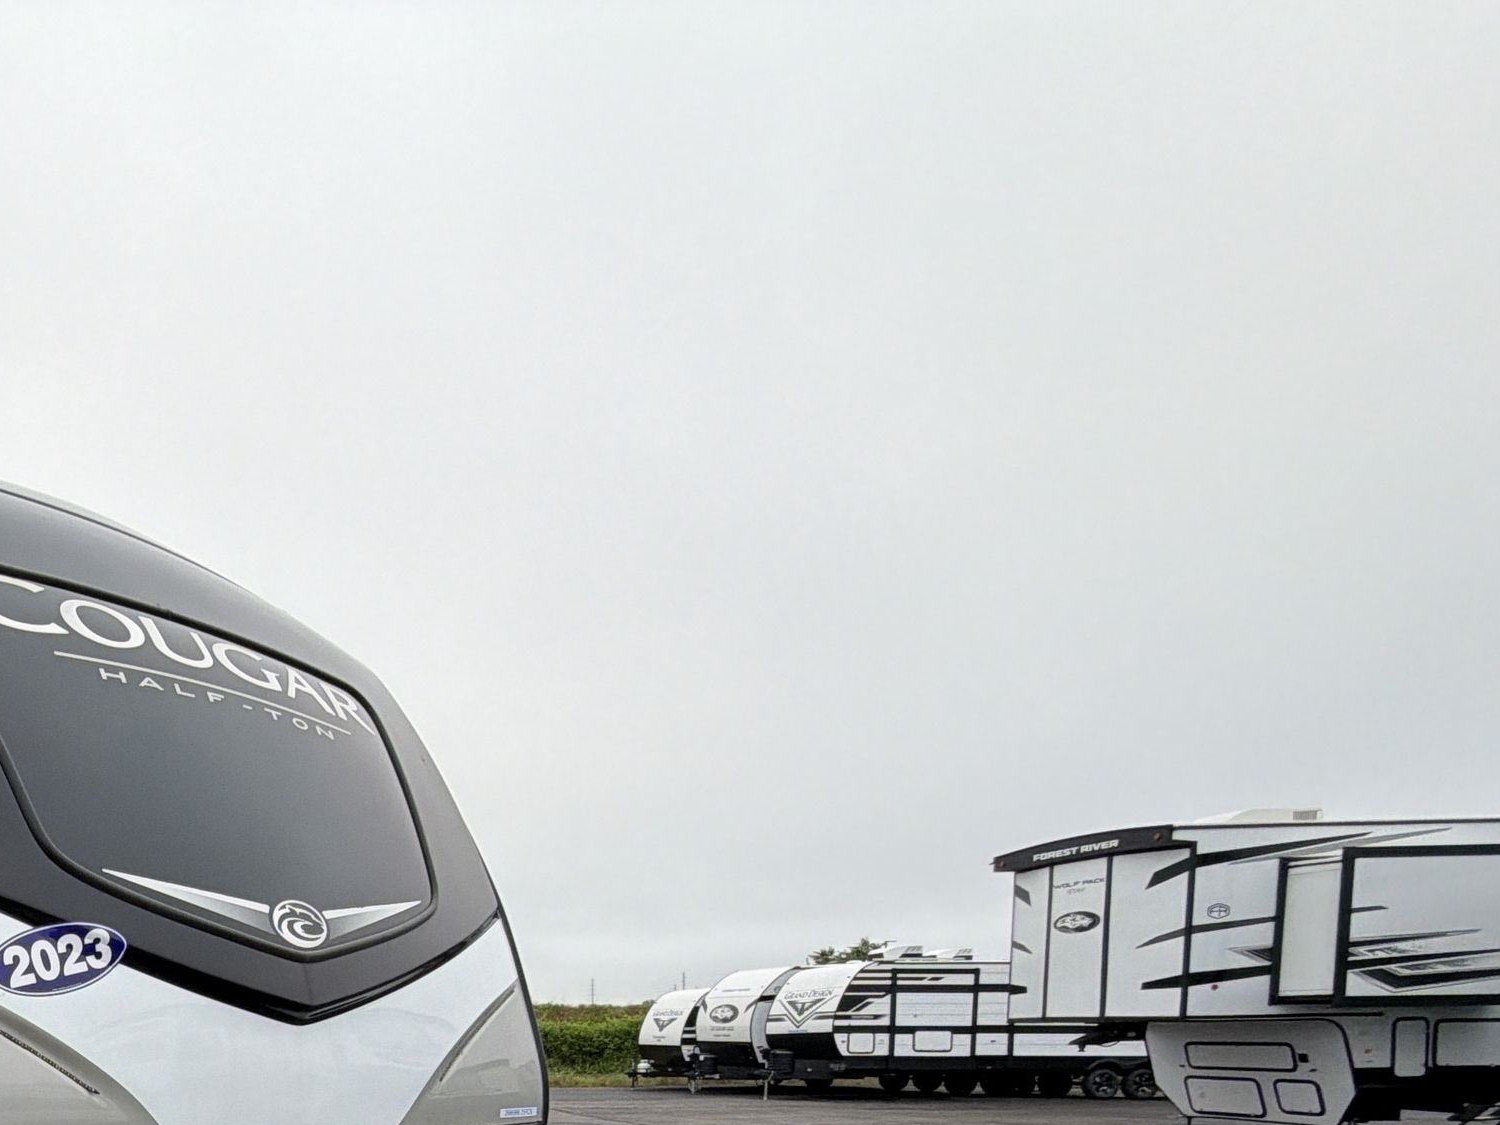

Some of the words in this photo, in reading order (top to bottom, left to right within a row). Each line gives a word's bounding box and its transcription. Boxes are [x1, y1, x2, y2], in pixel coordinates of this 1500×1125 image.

[1032, 846, 1080, 862] FOREST
[1080, 839, 1120, 853] RIVER
[2, 927, 113, 989] 2023
